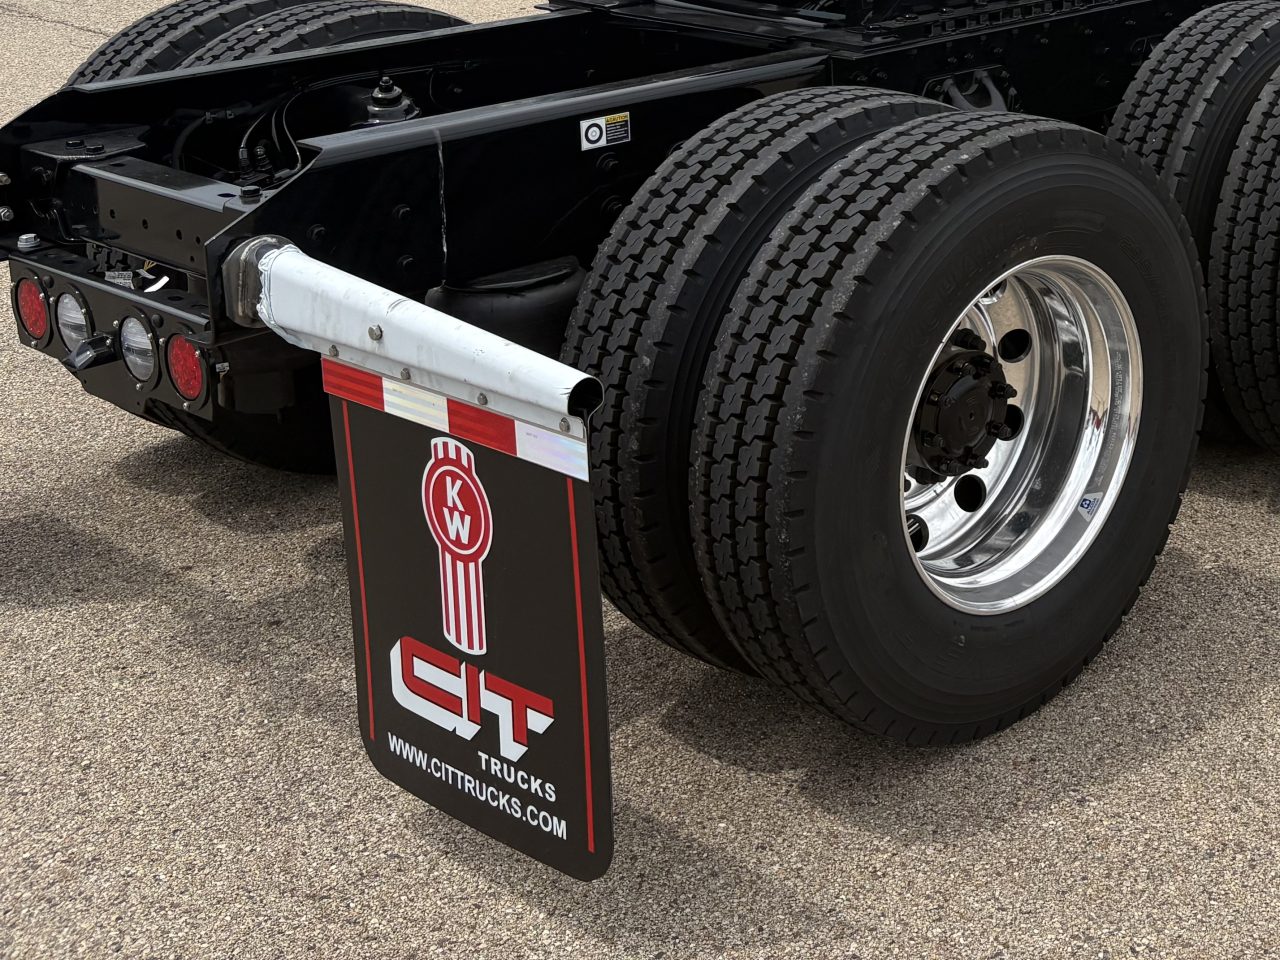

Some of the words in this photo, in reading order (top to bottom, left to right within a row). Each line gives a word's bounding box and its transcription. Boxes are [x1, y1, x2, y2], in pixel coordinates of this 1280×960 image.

[390, 636, 555, 763] CIT
[387, 731, 567, 841] WWW.CITTRUCKS.COM
[478, 751, 557, 803] TRUCKS
